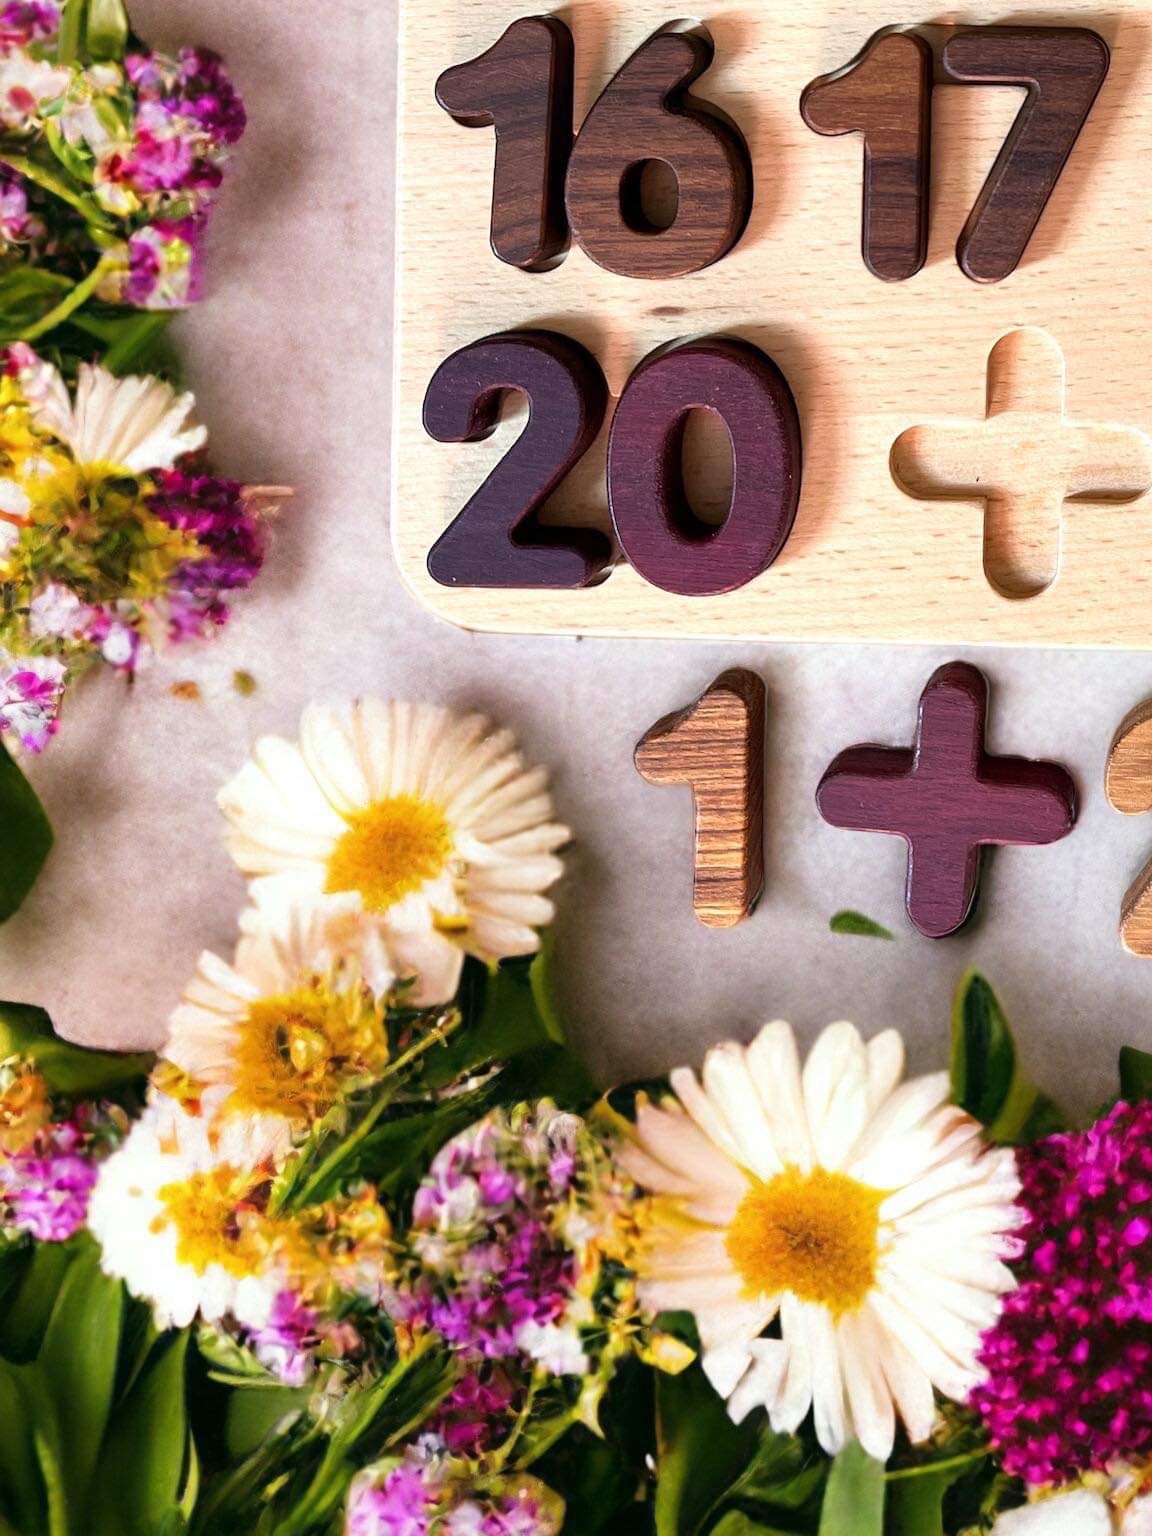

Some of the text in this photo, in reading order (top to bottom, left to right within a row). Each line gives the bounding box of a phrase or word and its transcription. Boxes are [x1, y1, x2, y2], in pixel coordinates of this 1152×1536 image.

[434, 15, 754, 280] 16
[800, 23, 1110, 284] 17
[422, 328, 803, 596] 20
[634, 668, 767, 928] 1
